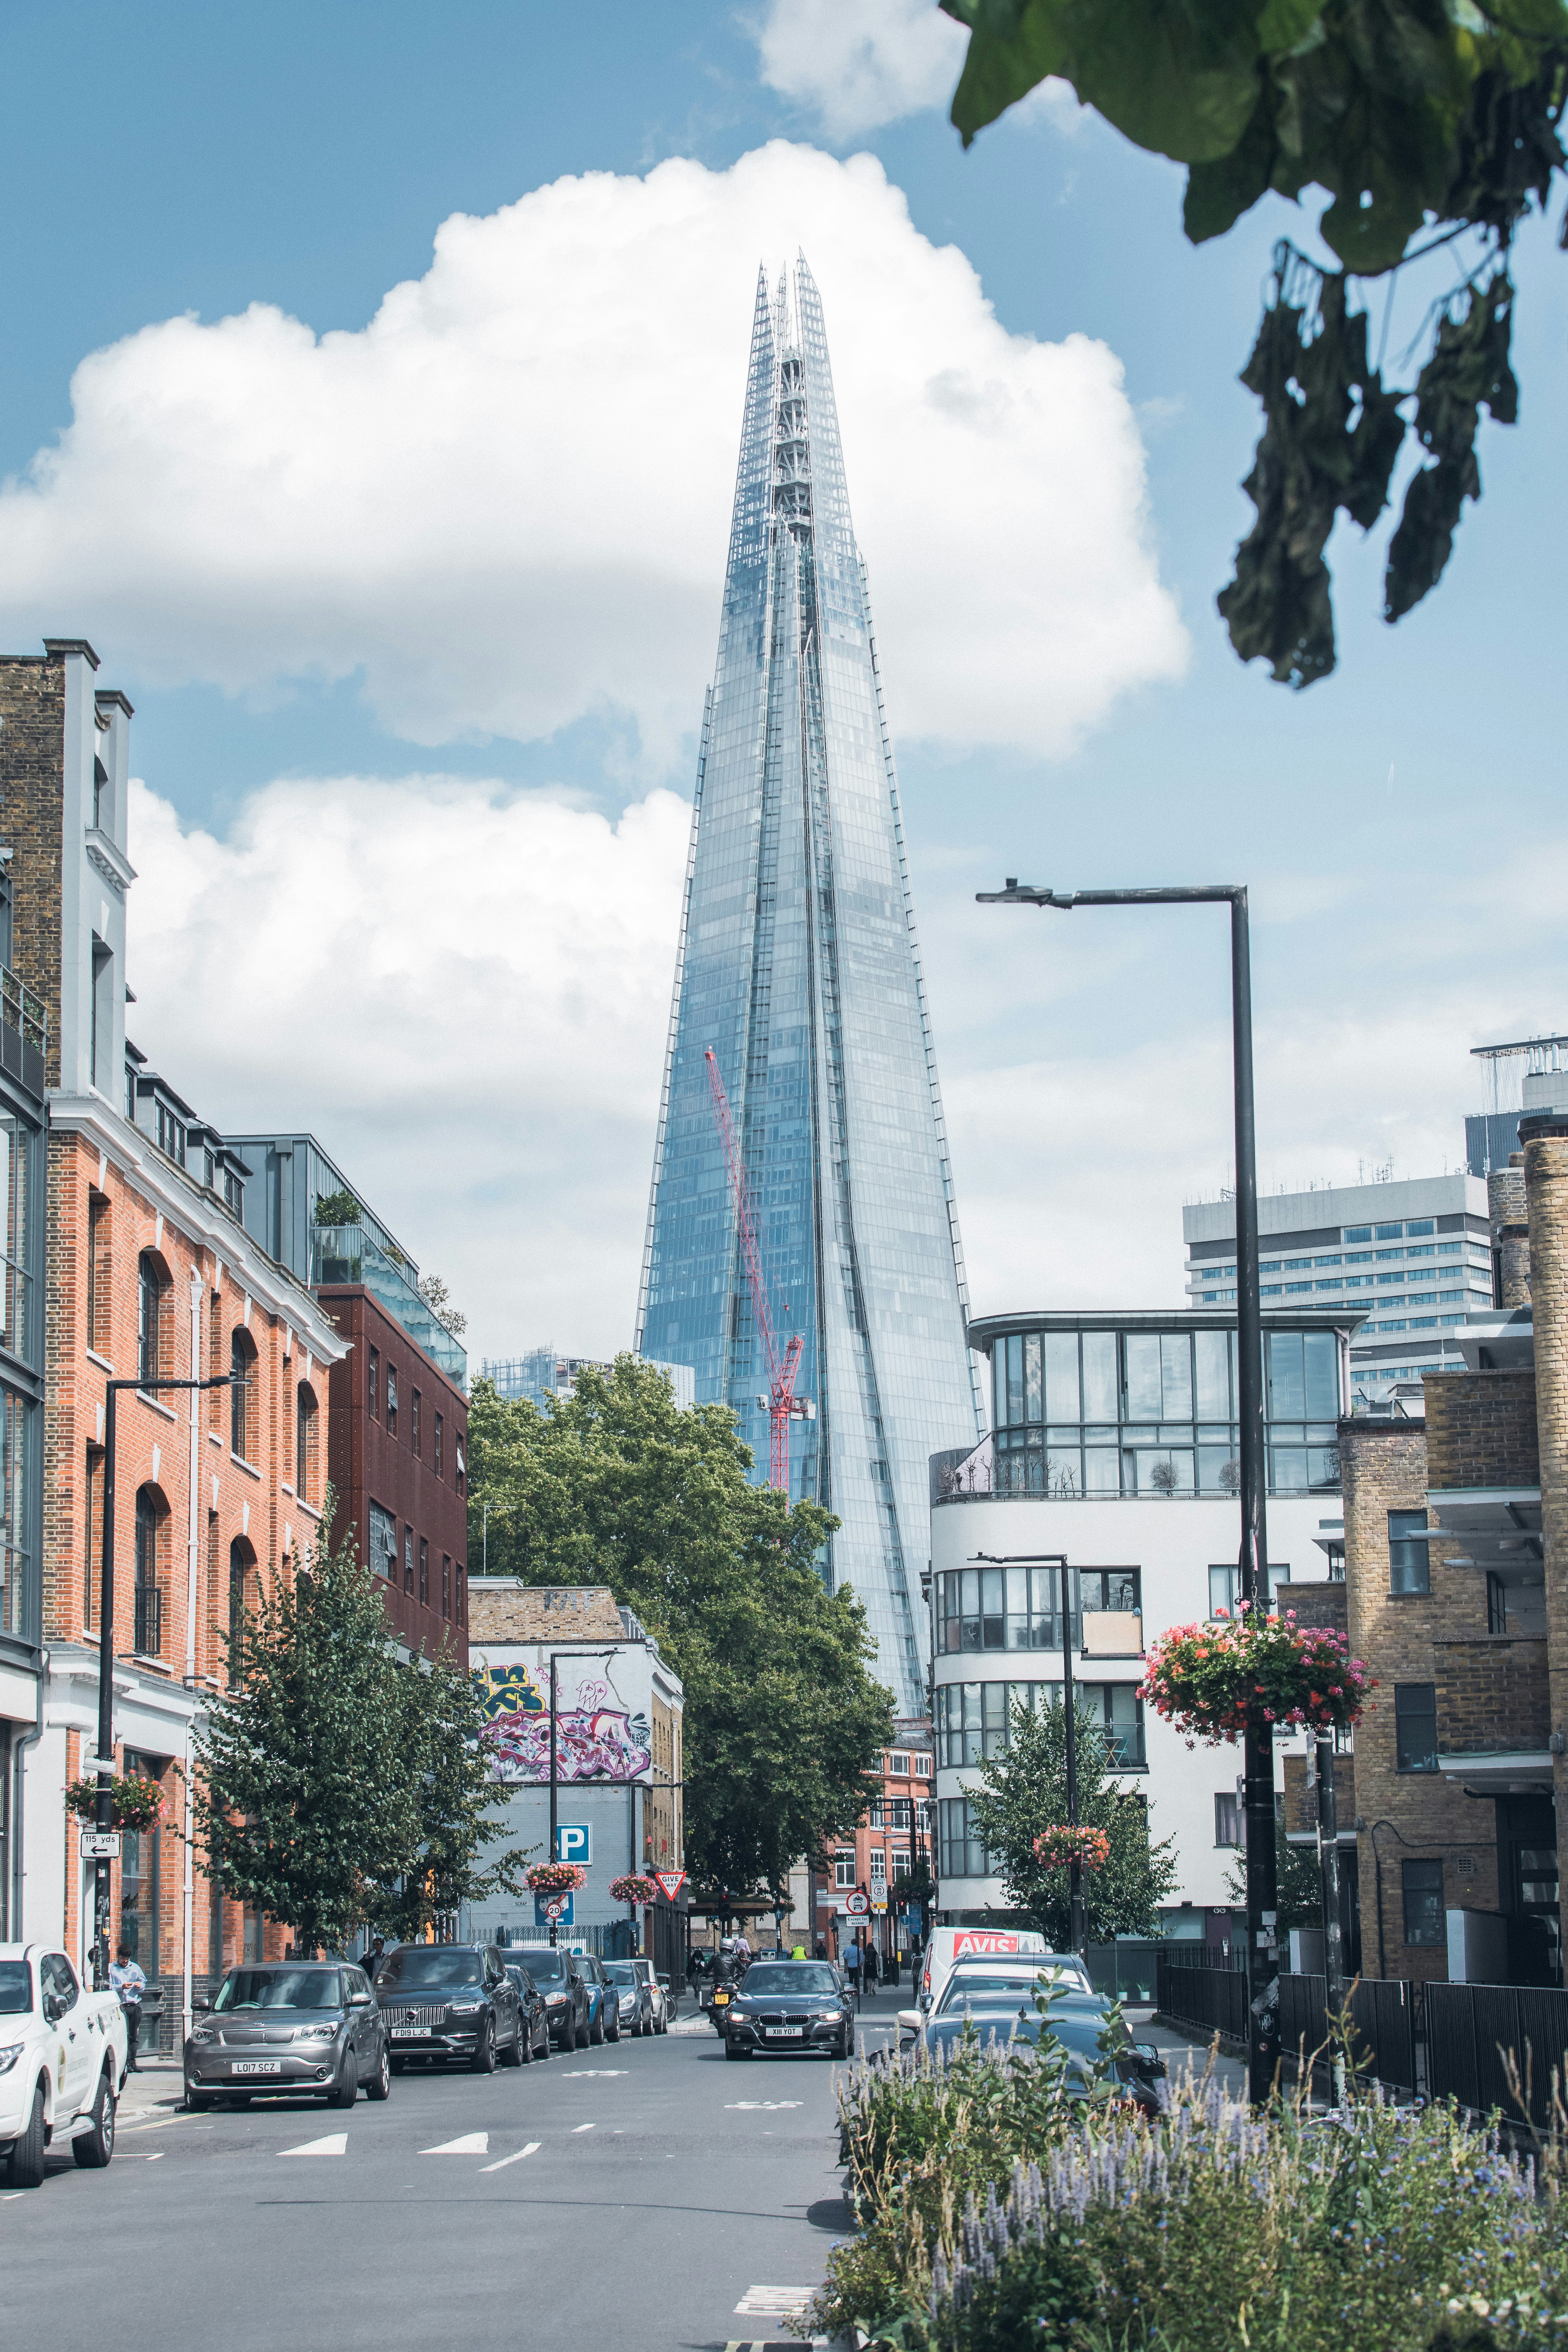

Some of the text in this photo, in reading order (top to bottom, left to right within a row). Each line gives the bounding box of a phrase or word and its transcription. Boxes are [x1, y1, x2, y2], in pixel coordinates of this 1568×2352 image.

[101, 1835, 115, 1843] yds
[561, 1828, 585, 1860] P
[957, 1937, 1010, 1954] AVIS
[259, 2063, 275, 2072] SCZ
